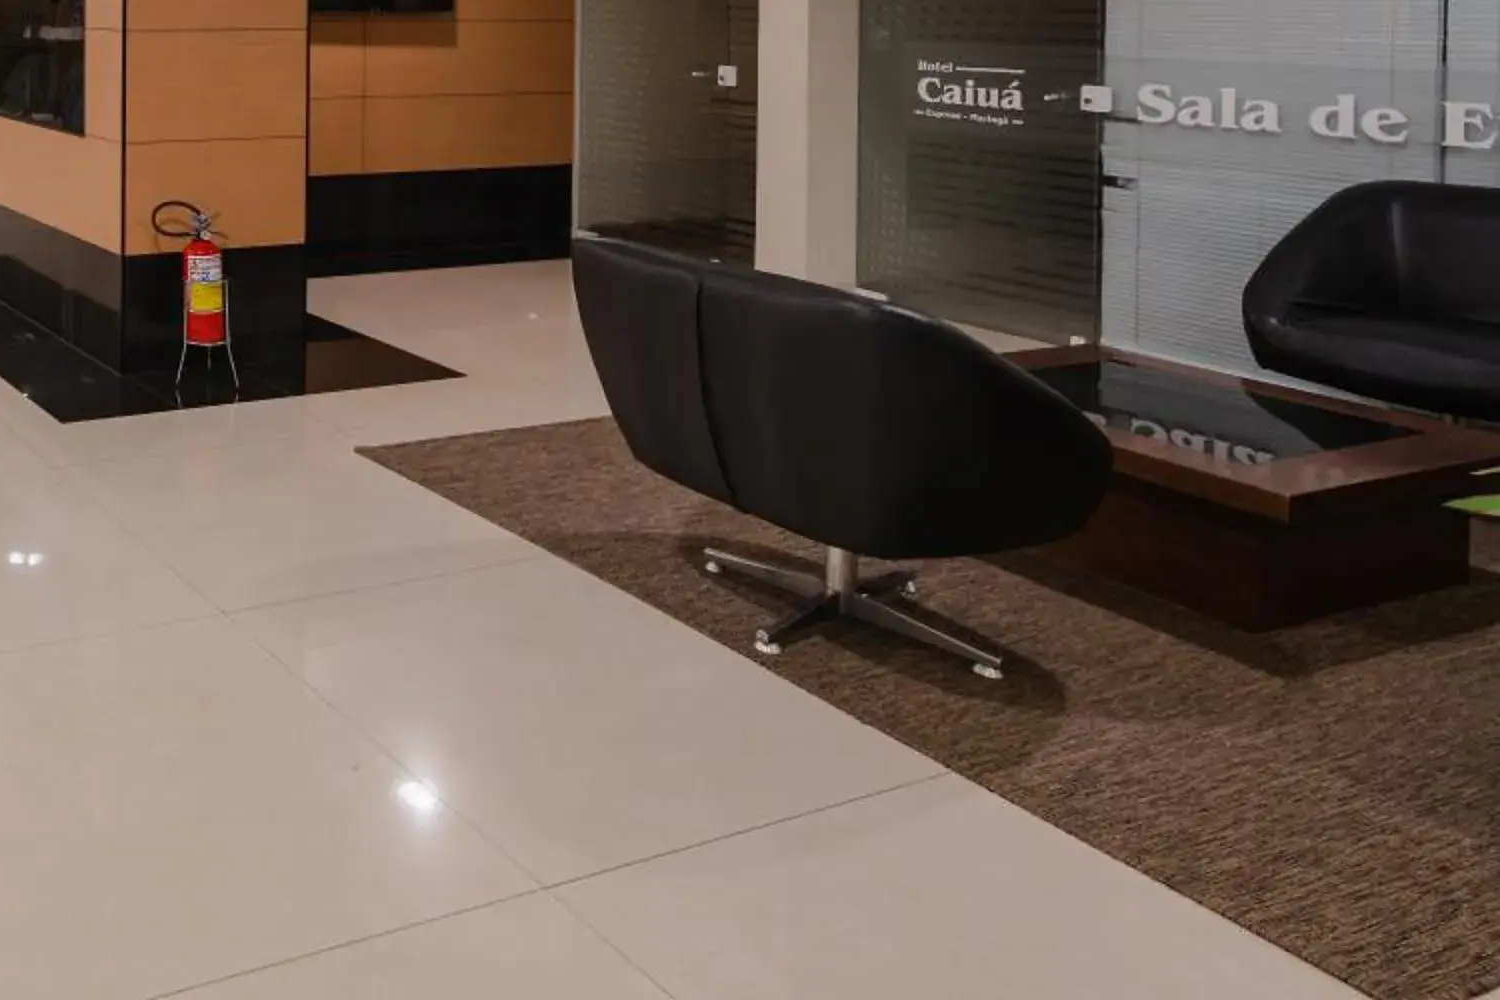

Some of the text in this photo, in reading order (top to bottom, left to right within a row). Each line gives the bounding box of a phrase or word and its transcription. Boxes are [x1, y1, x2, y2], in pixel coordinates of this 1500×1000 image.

[917, 60, 954, 73] Hotel
[917, 77, 1025, 111] Caiuá
[1136, 83, 1500, 149] Sala de E
